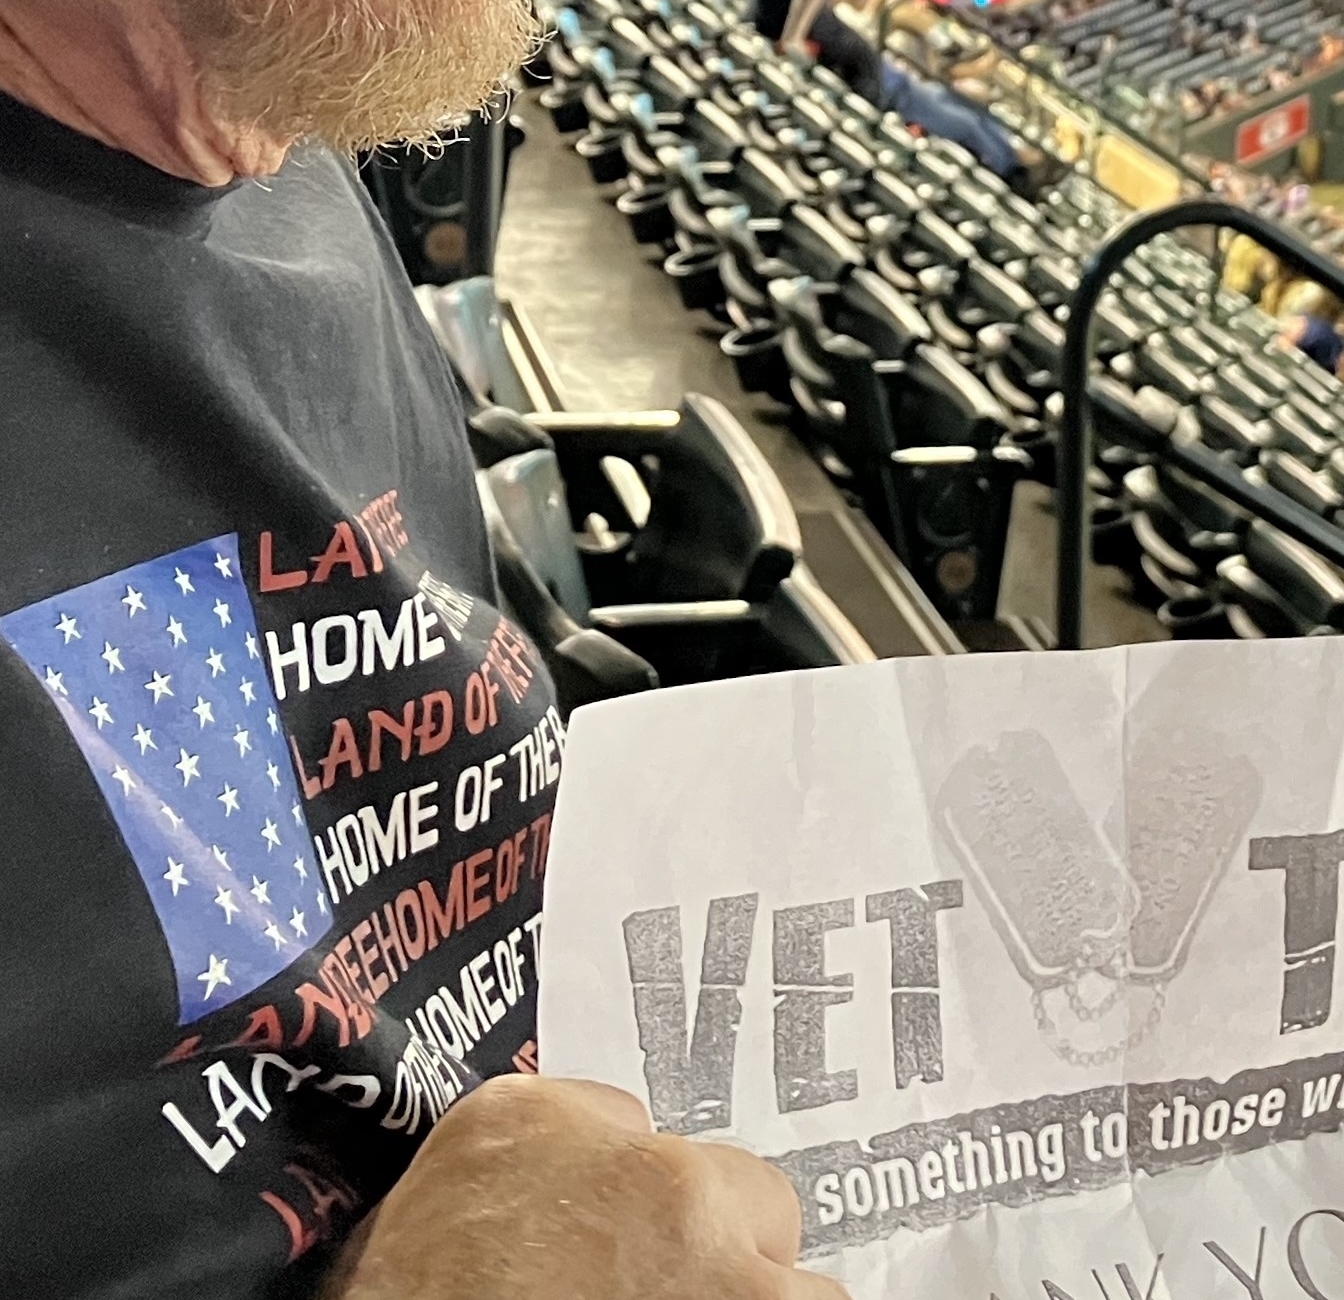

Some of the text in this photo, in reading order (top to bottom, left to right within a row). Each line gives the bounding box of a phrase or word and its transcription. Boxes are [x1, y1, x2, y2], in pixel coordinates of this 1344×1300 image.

[264, 591, 446, 701] HOME
[290, 690, 454, 801] LAND
[464, 661, 500, 736] OF
[314, 780, 440, 905] HOME
[454, 753, 507, 833] OF
[495, 827, 528, 904] OF
[406, 949, 507, 1061] HOME
[493, 926, 525, 1007] OF
[622, 879, 963, 1134] VET
[814, 1121, 1065, 1226] something
[1081, 1108, 1128, 1161] to
[1150, 1082, 1284, 1149] those
